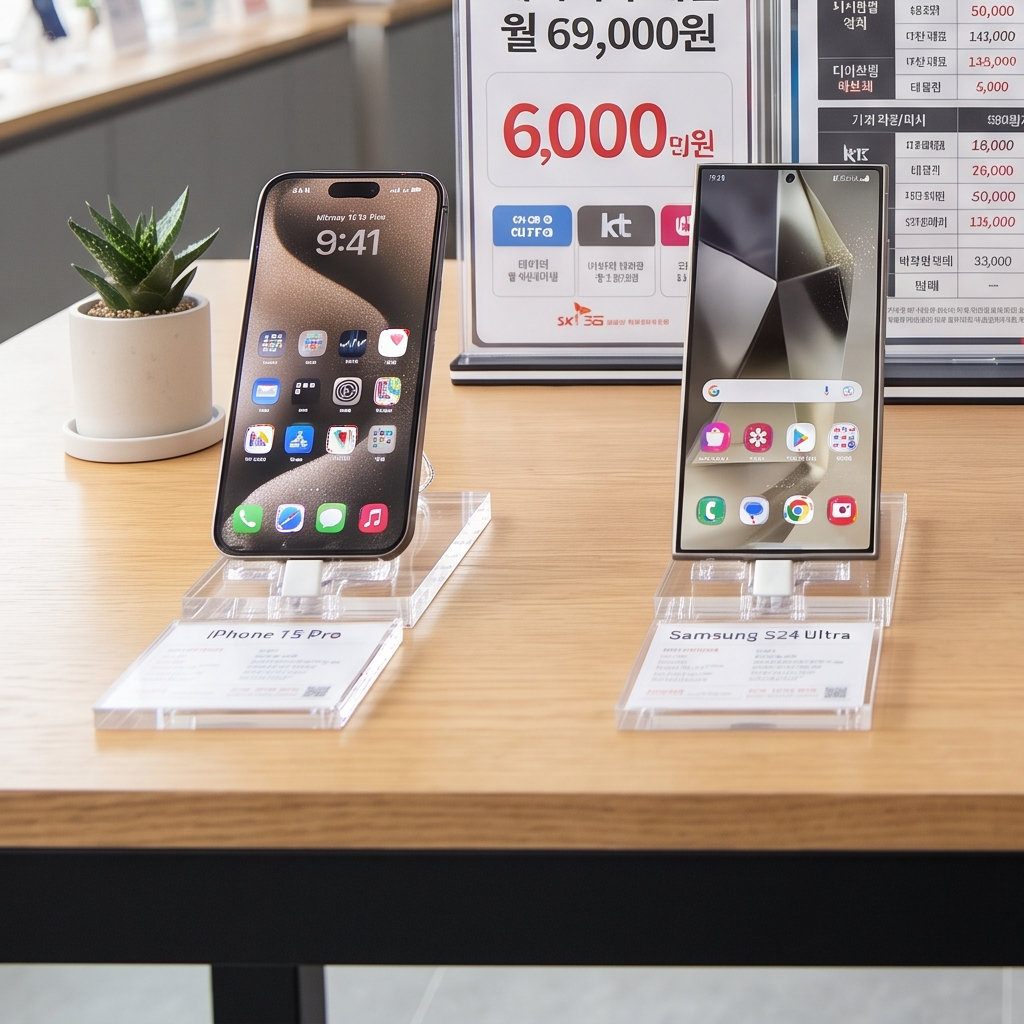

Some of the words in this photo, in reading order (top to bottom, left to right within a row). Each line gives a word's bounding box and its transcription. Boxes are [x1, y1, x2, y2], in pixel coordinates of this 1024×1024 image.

[971, 5, 1015, 19] 50,000
[500, 12, 538, 53] 월
[547, 13, 716, 60] 69,000원
[600, 212, 632, 238] kt
[315, 228, 381, 256] 9:41
[306, 629, 342, 640] Pro
[669, 630, 758, 643] Samsung
[764, 630, 800, 640] S24
[804, 629, 851, 640] Ultra
